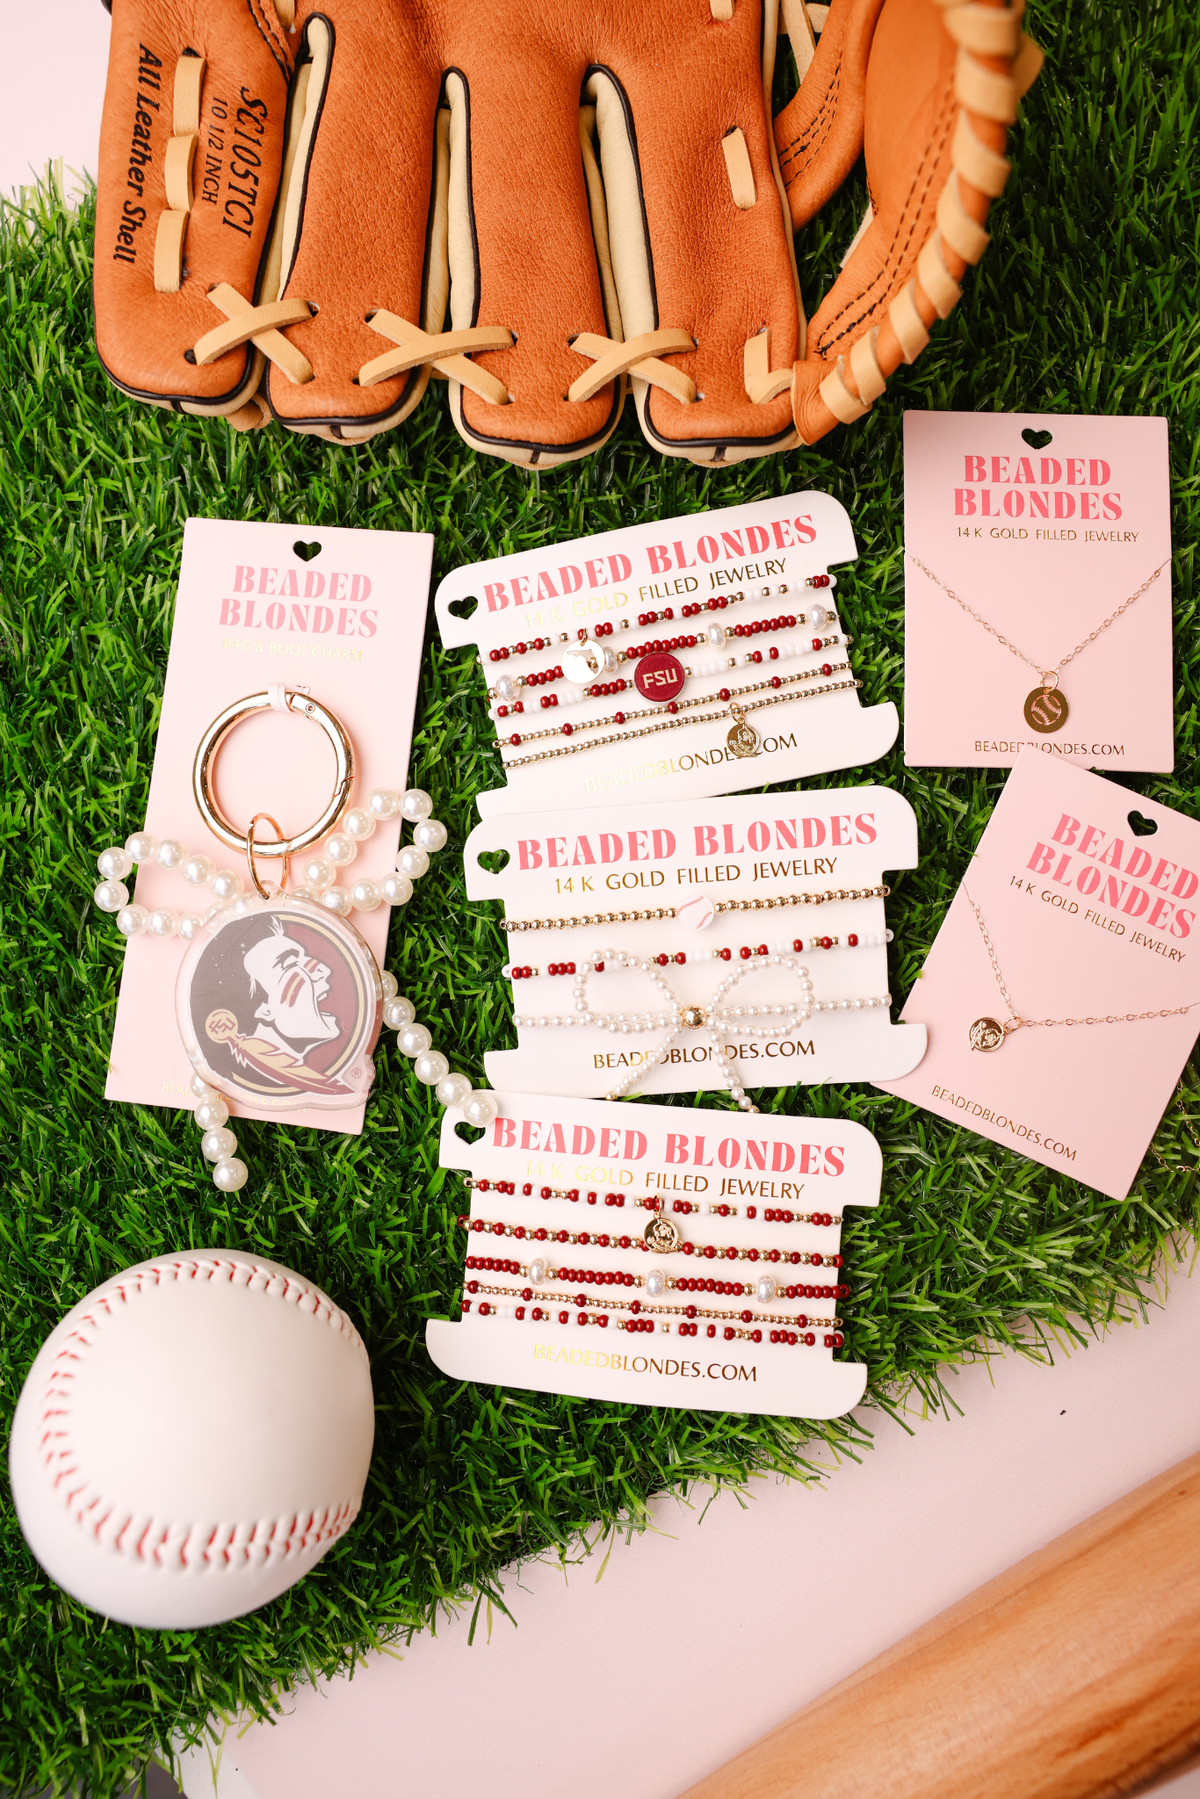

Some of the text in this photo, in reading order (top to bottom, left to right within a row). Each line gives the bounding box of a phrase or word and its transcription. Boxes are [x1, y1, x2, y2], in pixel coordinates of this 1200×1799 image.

[113, 43, 163, 263] All Leather Shell
[202, 97, 228, 205] 10 1/2 INCH
[222, 86, 268, 239] SC105TCI
[964, 455, 1112, 486] BEADED
[954, 488, 1123, 521] BLONDES
[956, 527, 1139, 543] 14 K GOLD FILLED JEWELRY
[233, 564, 372, 602] BEADED
[483, 514, 818, 613] BEADED BLONDES
[523, 557, 787, 630] 14 K GOLD FILLED JEWELRY
[218, 598, 379, 638] BLONDES
[223, 637, 363, 662] BAG & BOOT CHARM
[642, 668, 678, 689] FSU
[974, 740, 1125, 756] BEADEDONDES.COM
[516, 812, 878, 871] BEADED BLONDES
[1050, 812, 1199, 901] BEADED
[553, 856, 838, 895] 14 K GOLD FILLED JEWELRY
[1025, 841, 1197, 940] BLONDES
[1009, 875, 1186, 964] 14 K GOLD FILLED JEWELRY
[208, 1017, 236, 1035] FSU
[931, 1084, 1078, 1162] BEADEDBLONDES.COM
[492, 1116, 846, 1177] BEADED BLONDES
[525, 1161, 805, 1200] 14 K GOLD FILLED JEWELRY
[533, 1343, 757, 1382] BEADEDBLONDES.COM
